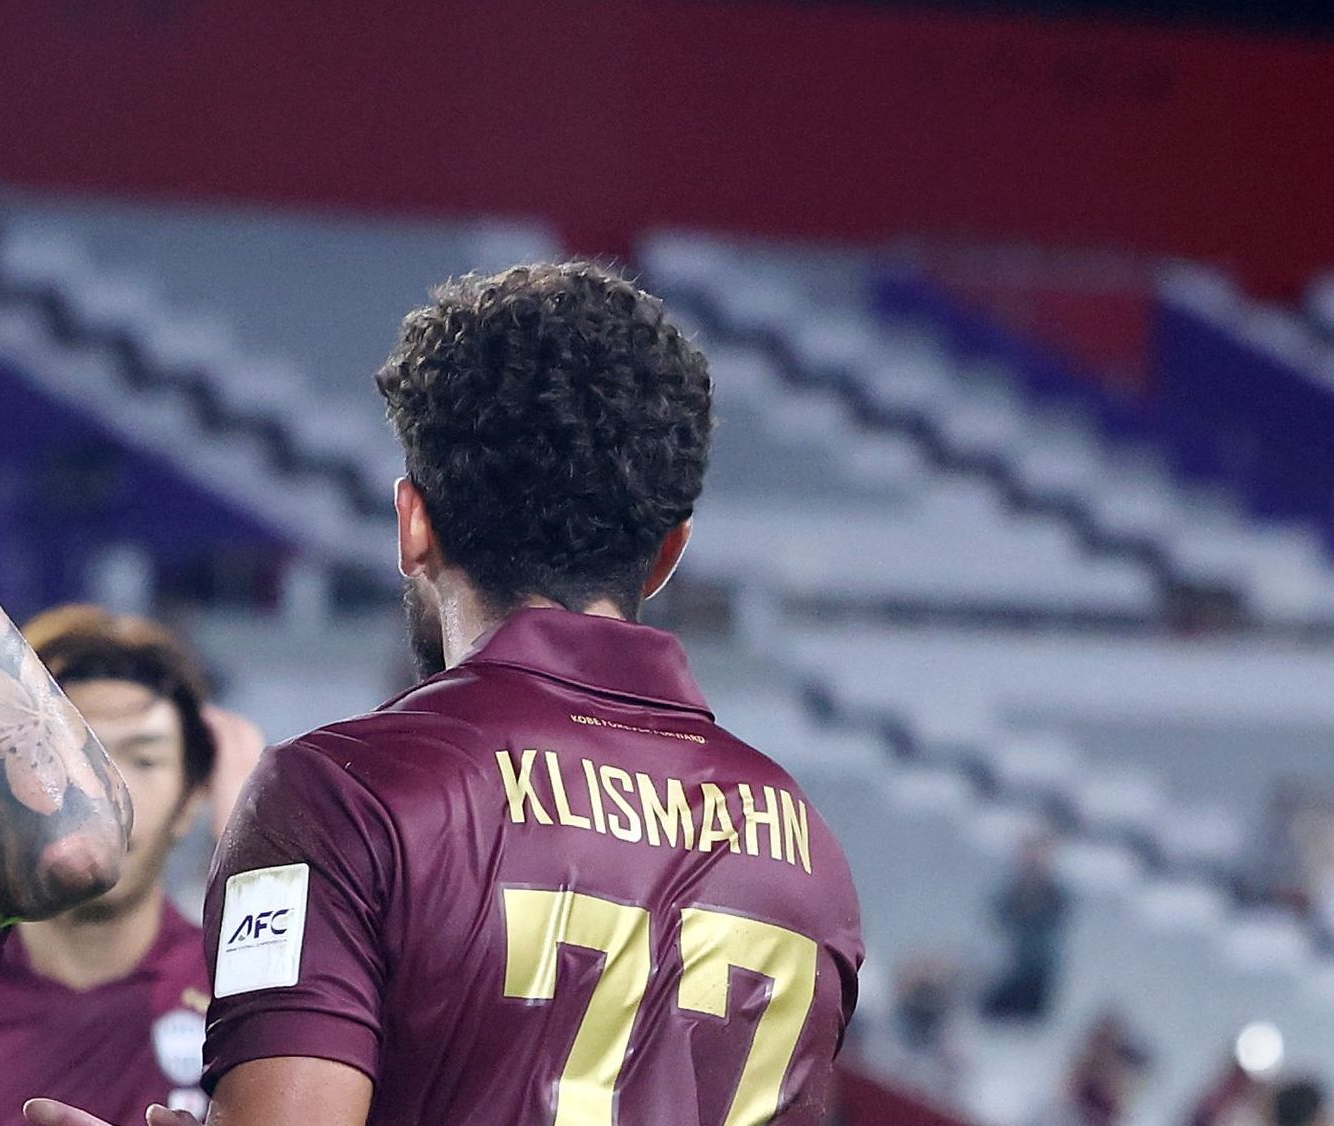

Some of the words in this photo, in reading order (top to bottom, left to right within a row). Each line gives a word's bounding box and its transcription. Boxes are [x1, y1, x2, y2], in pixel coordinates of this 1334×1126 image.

[570, 713, 602, 727] KOBE
[495, 749, 812, 875] KLISMAHN
[227, 908, 290, 945] AFC
